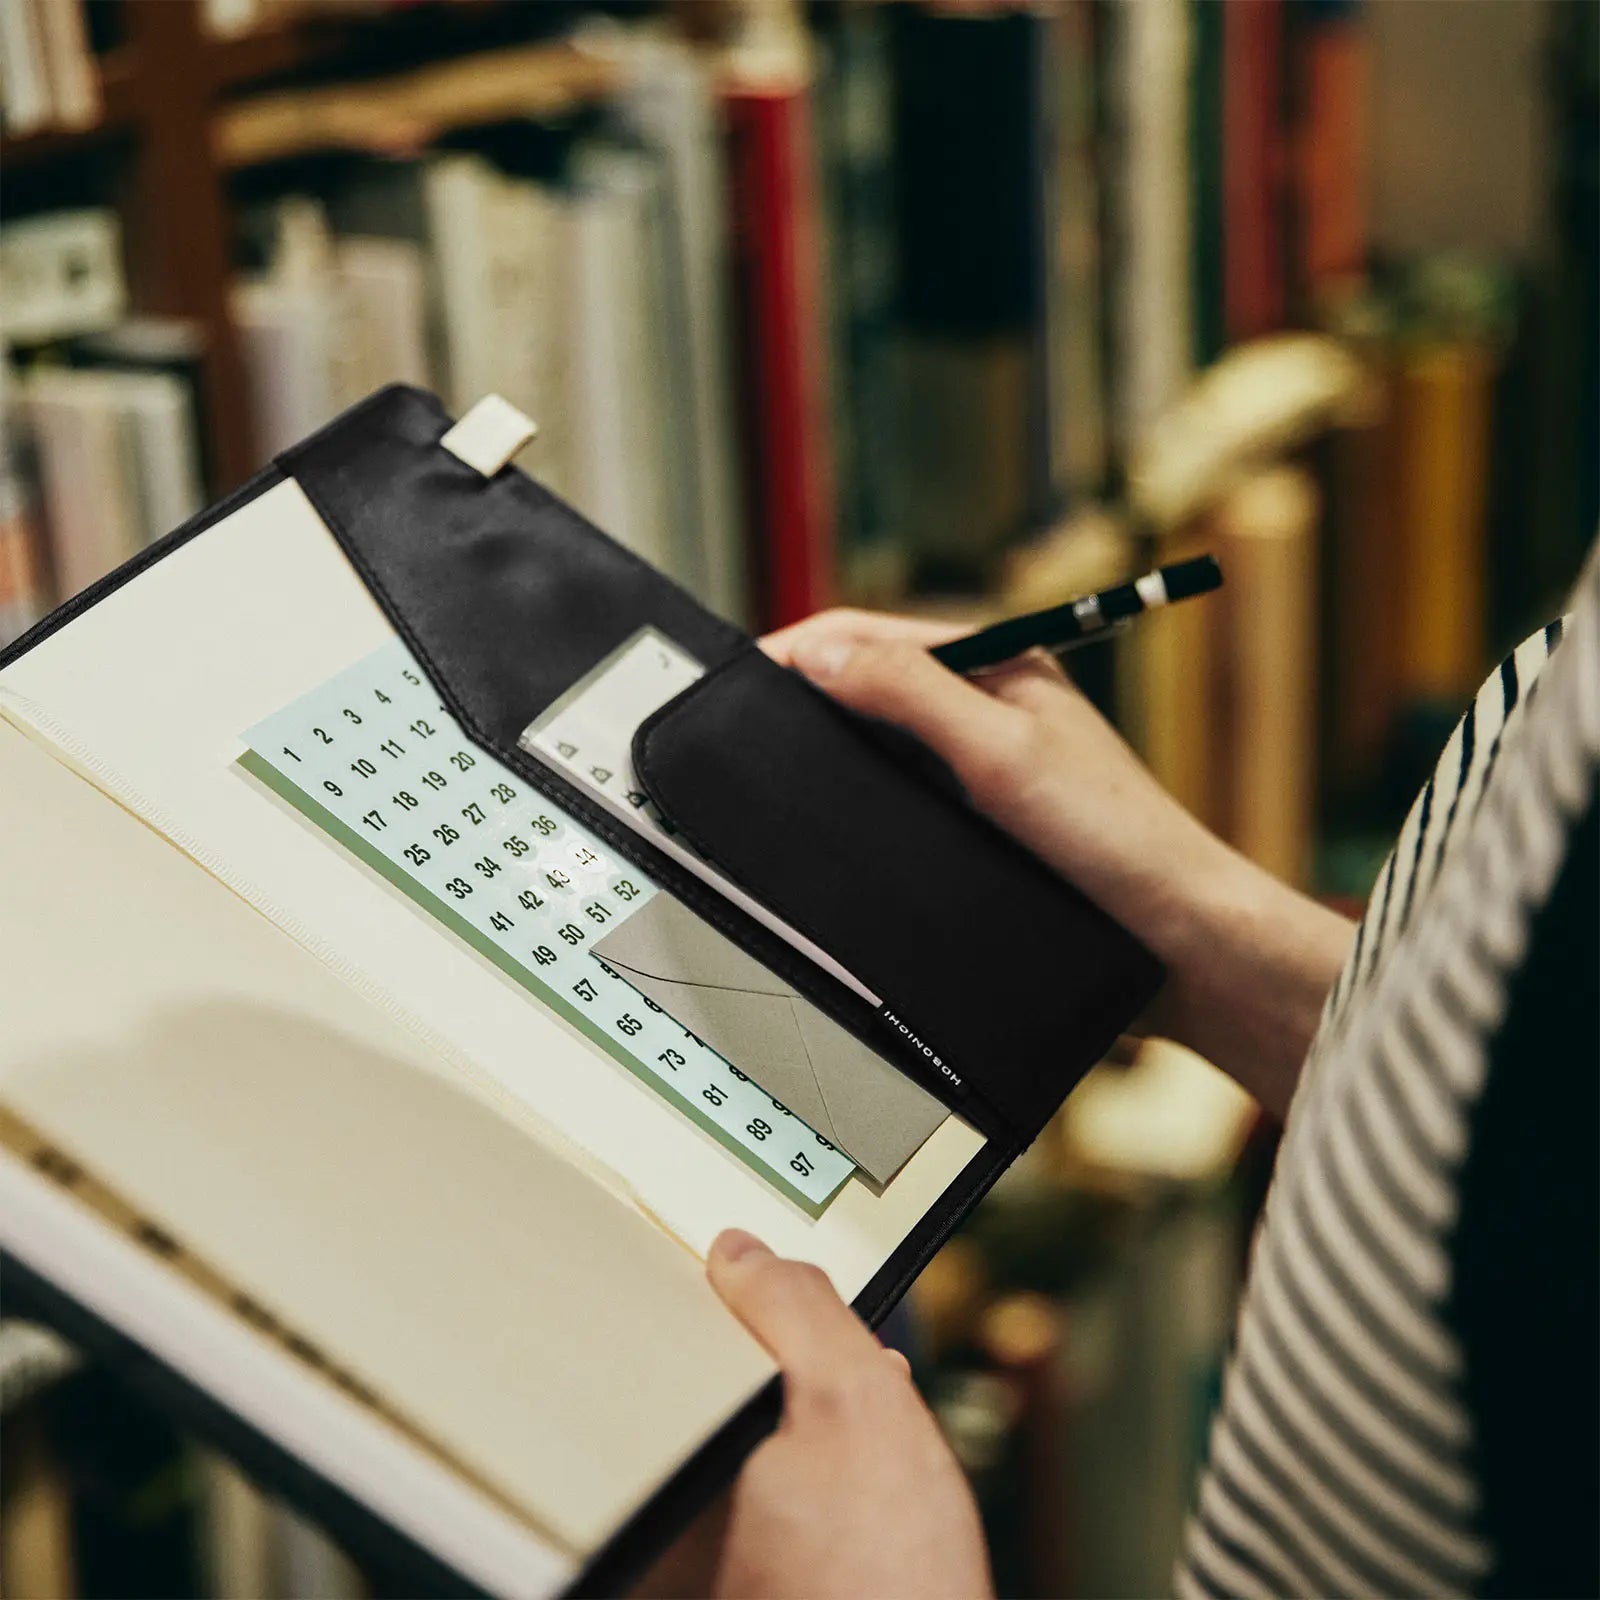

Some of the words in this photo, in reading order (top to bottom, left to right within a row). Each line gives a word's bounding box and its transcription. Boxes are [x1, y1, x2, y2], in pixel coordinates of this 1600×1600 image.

[283, 746, 302, 763] 1
[312, 727, 334, 745] 2
[342, 708, 363, 725] 3
[373, 688, 392, 704] 4
[402, 669, 421, 686] 5
[322, 780, 344, 797] 9
[350, 758, 378, 779] 10
[380, 739, 406, 759] 11
[409, 719, 436, 740] 12
[362, 809, 388, 832] 17
[392, 790, 419, 812] 18
[421, 771, 448, 791] 19
[449, 751, 476, 773] 20
[403, 843, 432, 867] 25
[432, 823, 461, 847] 26
[461, 802, 487, 826] 27
[490, 783, 517, 805] 28
[445, 877, 474, 900] 33
[474, 856, 503, 879] 34
[502, 835, 530, 858] 35
[530, 815, 557, 836] 36
[489, 911, 515, 932] 41
[517, 890, 545, 911] 42
[546, 869, 571, 889] 43
[531, 945, 558, 967] 49
[557, 923, 586, 946] 50
[585, 901, 612, 924] 51
[612, 879, 641, 902] 52
[571, 977, 599, 1002] 57
[615, 1012, 643, 1037] 65
[883, 1010, 962, 1086] HOBONICHI
[657, 1048, 686, 1072] 73
[702, 1083, 729, 1107] 81
[745, 1117, 773, 1142] 89
[789, 1151, 815, 1177] 97
